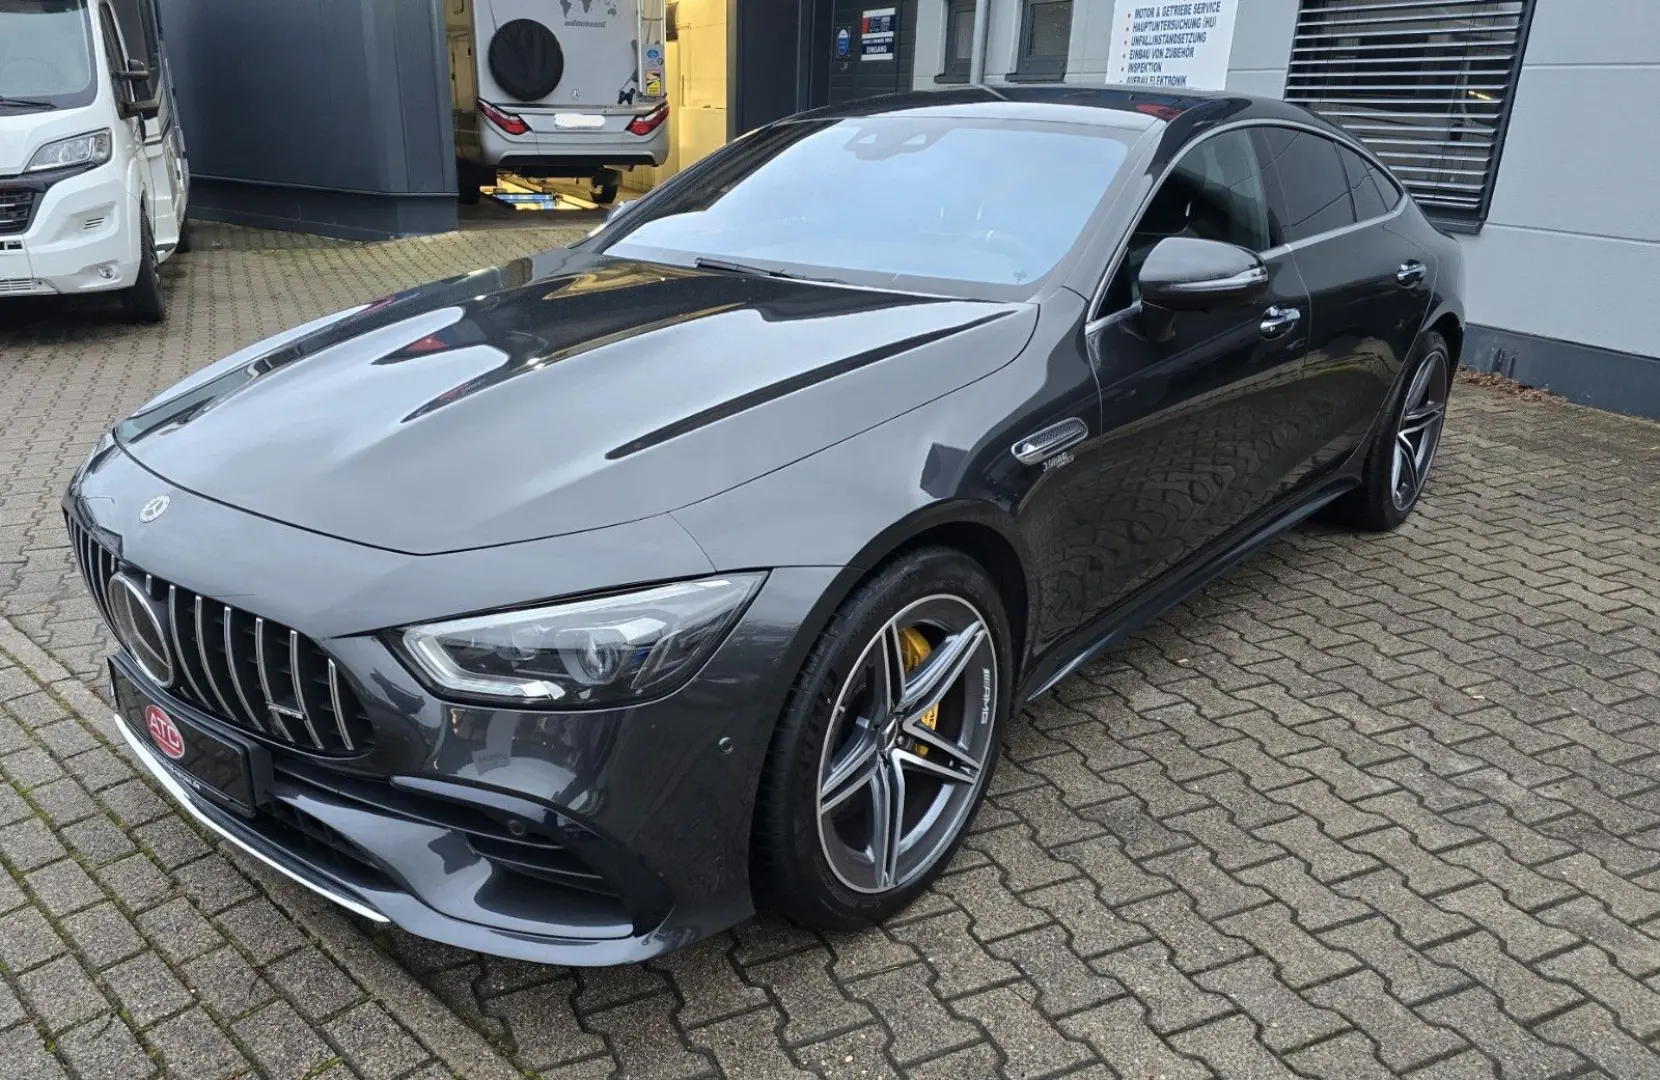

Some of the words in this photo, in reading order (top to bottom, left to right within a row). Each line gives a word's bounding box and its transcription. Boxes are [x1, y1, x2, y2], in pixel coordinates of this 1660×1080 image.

[1134, 5, 1155, 19] MOTOR
[1155, 6, 1161, 17] &
[1161, 3, 1192, 17] GETRIEBE
[1193, 1, 1221, 15] SERVICE
[1132, 18, 1201, 33] HAUPTUNTERSUCHUNG
[1131, 31, 1207, 46] UNFALLINSTANDSETZUNG
[1129, 48, 1151, 60] EINBAU
[1151, 48, 1164, 59] VON
[1127, 61, 1162, 73] INSPEKTION
[150, 712, 180, 748] ATC
